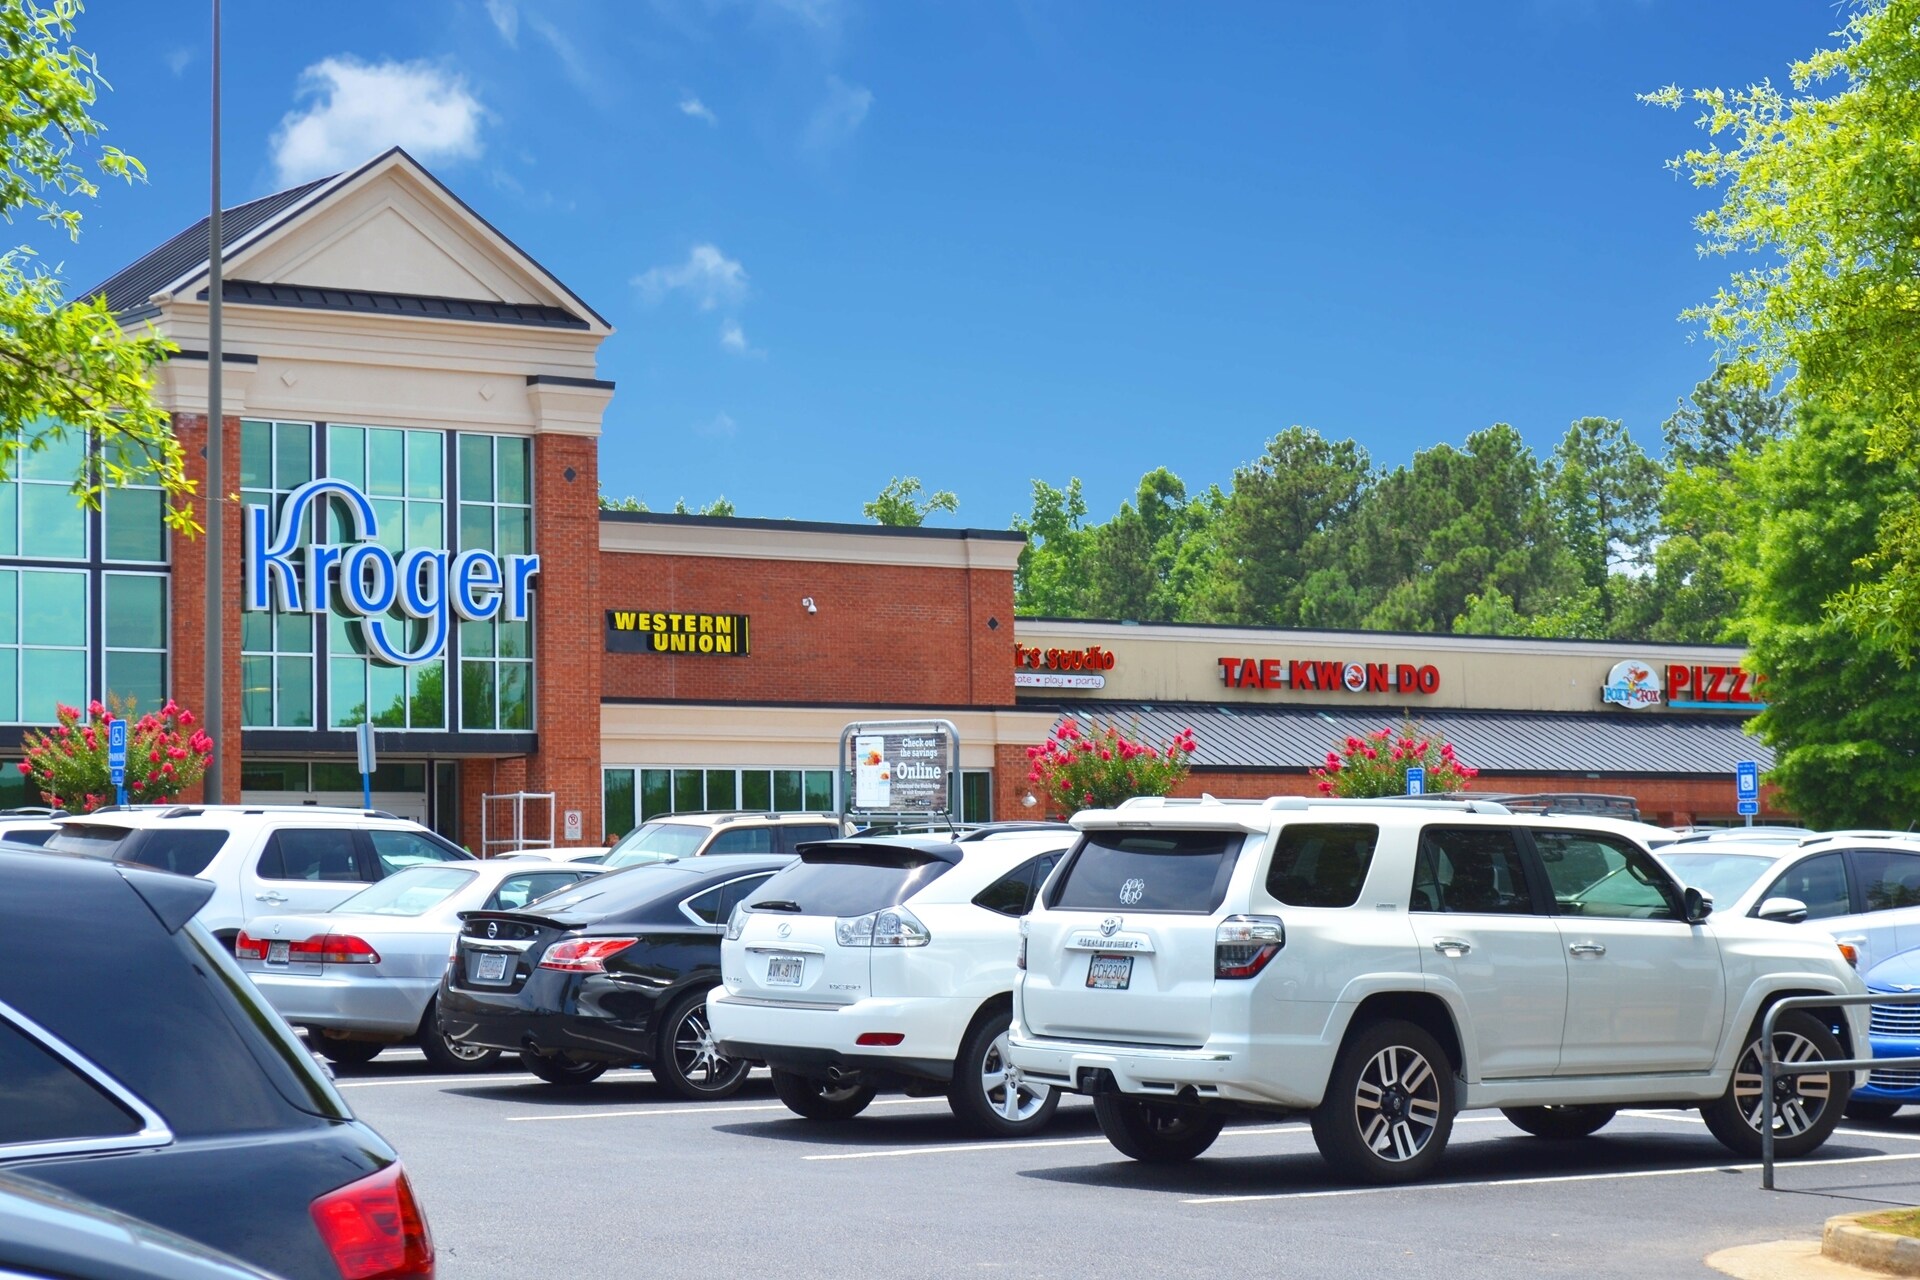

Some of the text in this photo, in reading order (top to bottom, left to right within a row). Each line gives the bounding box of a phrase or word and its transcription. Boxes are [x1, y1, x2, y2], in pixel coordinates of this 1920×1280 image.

[245, 477, 540, 667] Kroger
[614, 611, 731, 634] WESTERN
[653, 633, 732, 653] UNION
[1044, 674, 1063, 687] play
[1075, 679, 1101, 688] party
[1218, 657, 1282, 689] TAE
[1396, 664, 1441, 694] DO
[902, 738, 936, 747] Check out
[900, 748, 938, 759] the savings
[896, 762, 941, 780] Online
